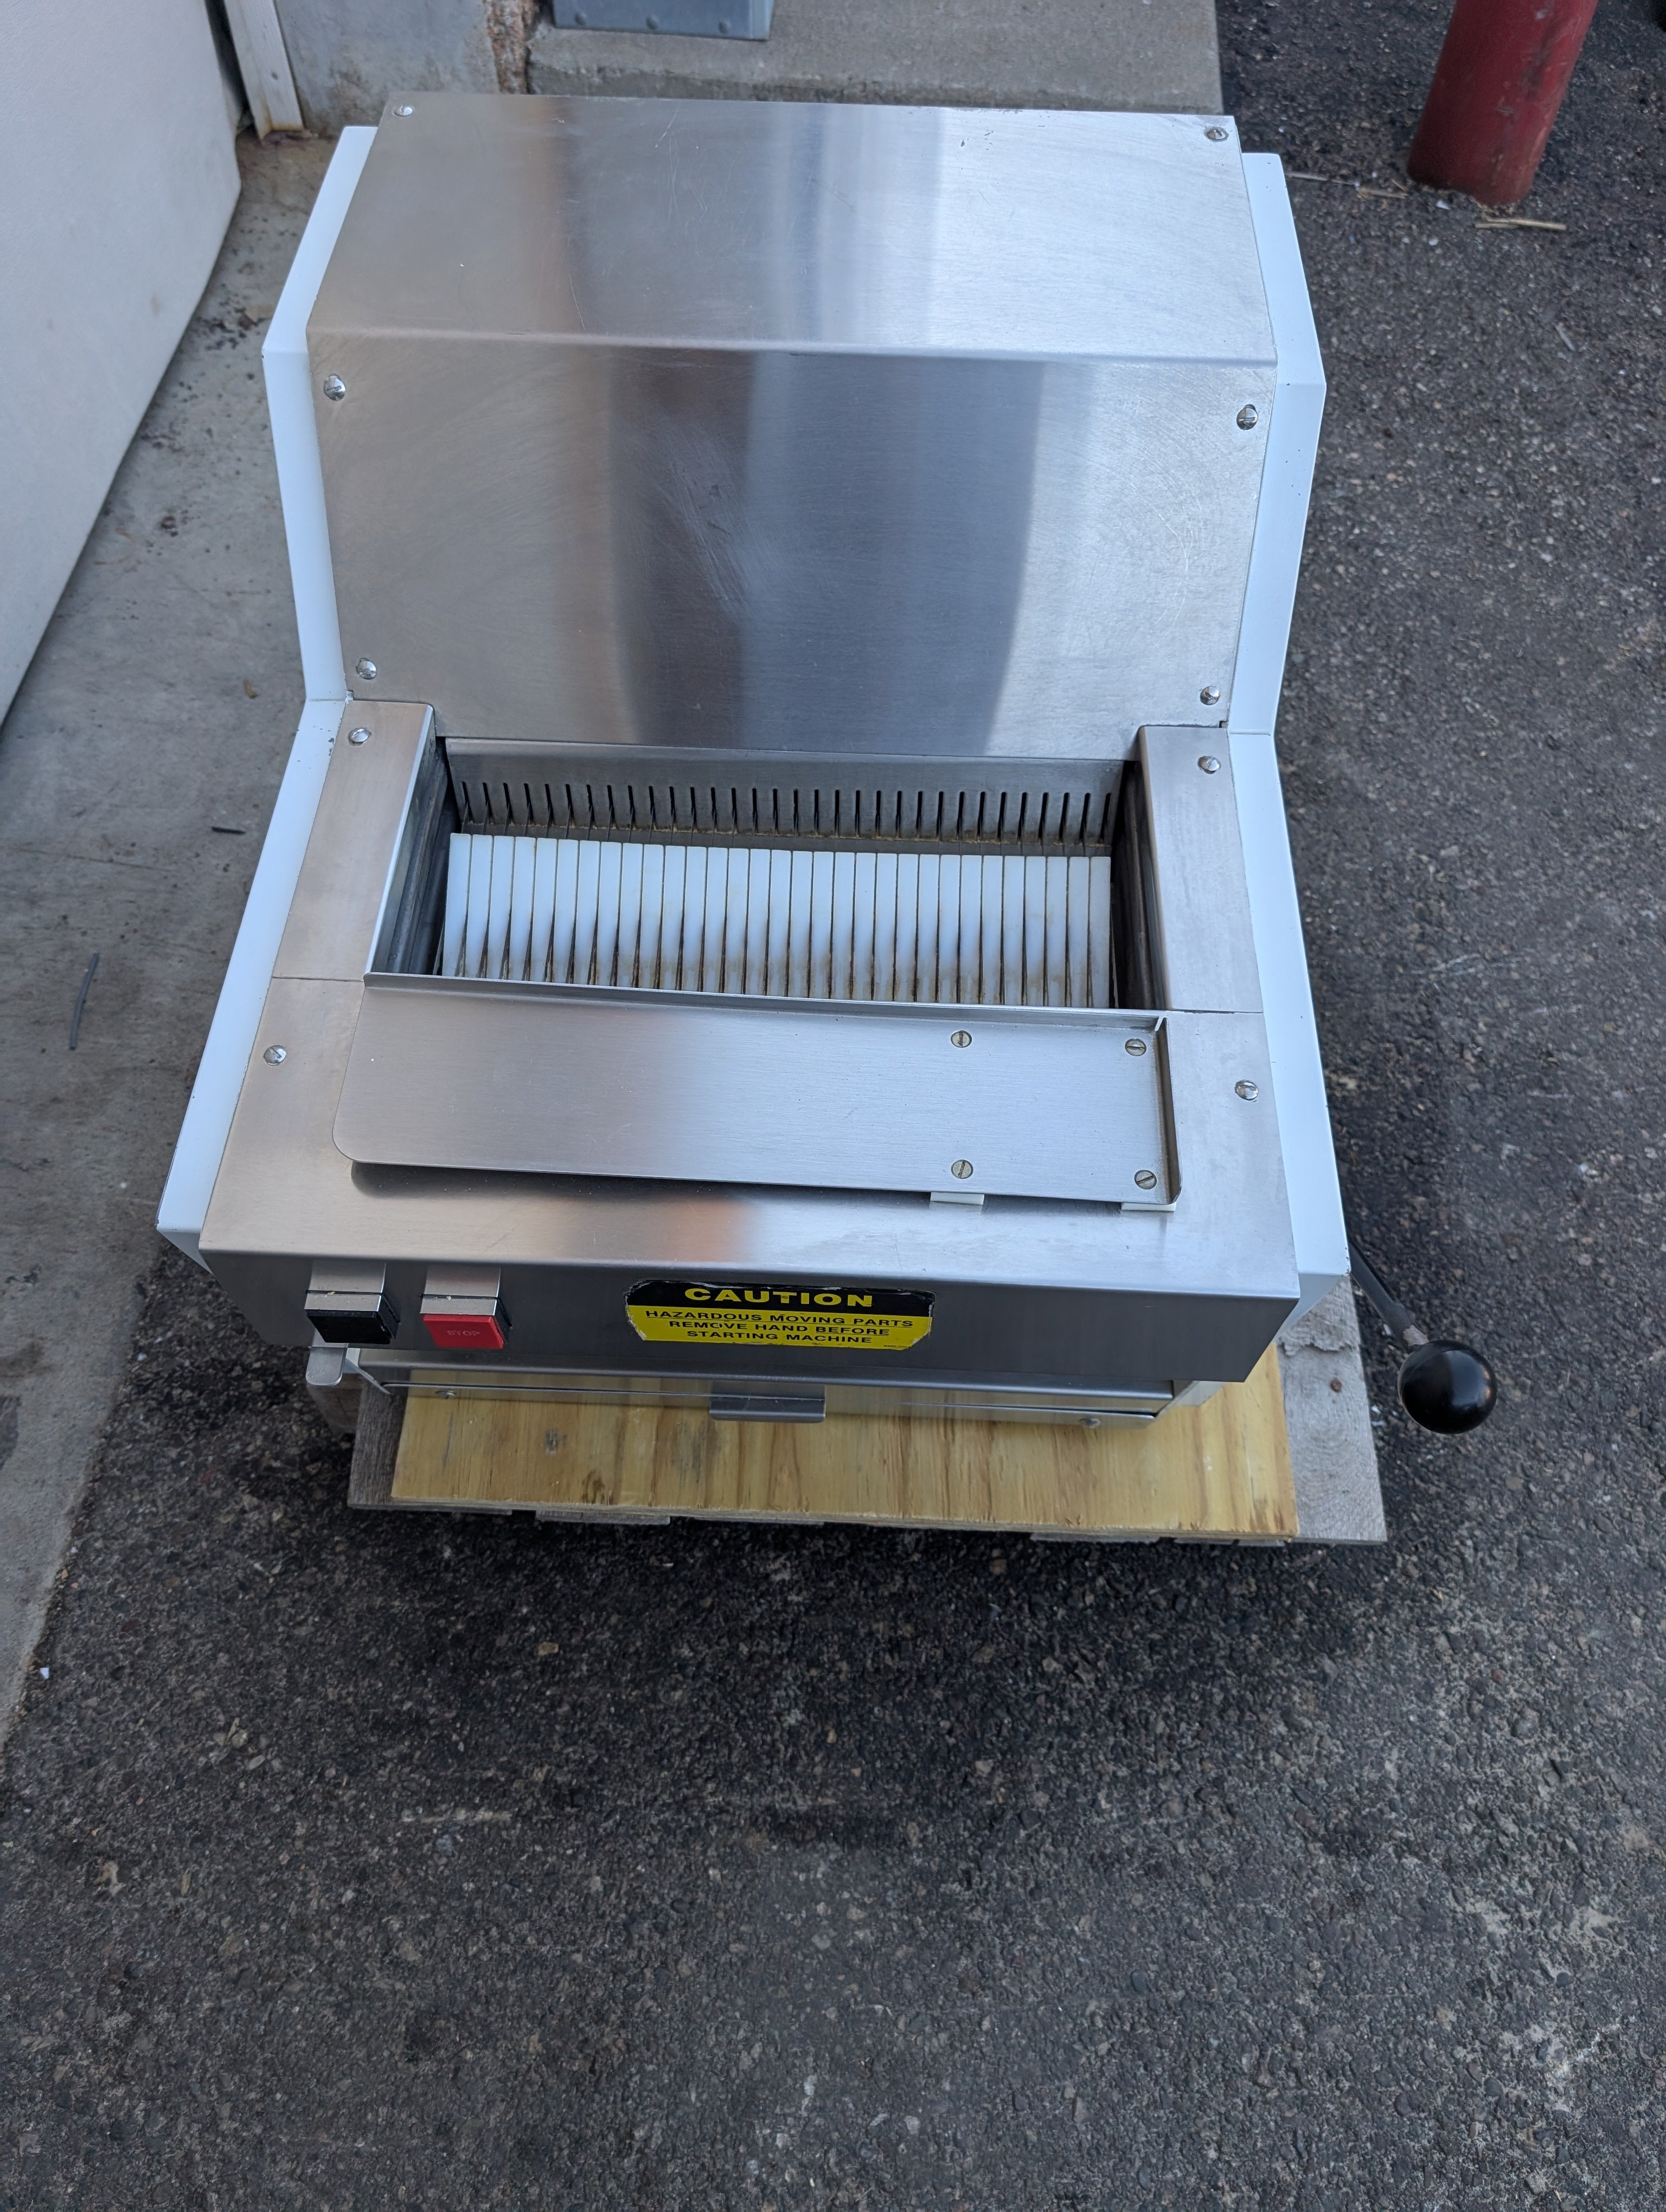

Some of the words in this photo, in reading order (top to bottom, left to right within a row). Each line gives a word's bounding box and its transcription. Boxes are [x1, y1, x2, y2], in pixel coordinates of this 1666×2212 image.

[684, 1288, 873, 1307] CAUTION
[645, 1310, 762, 1321] HAZARDOUS
[770, 1315, 845, 1324] MOVING
[854, 1318, 913, 1327] PARTS
[669, 1321, 748, 1329] REMOVE
[816, 1326, 890, 1335] BEFORE
[687, 1330, 778, 1340] STARTING
[786, 1334, 872, 1343] MACHINE
